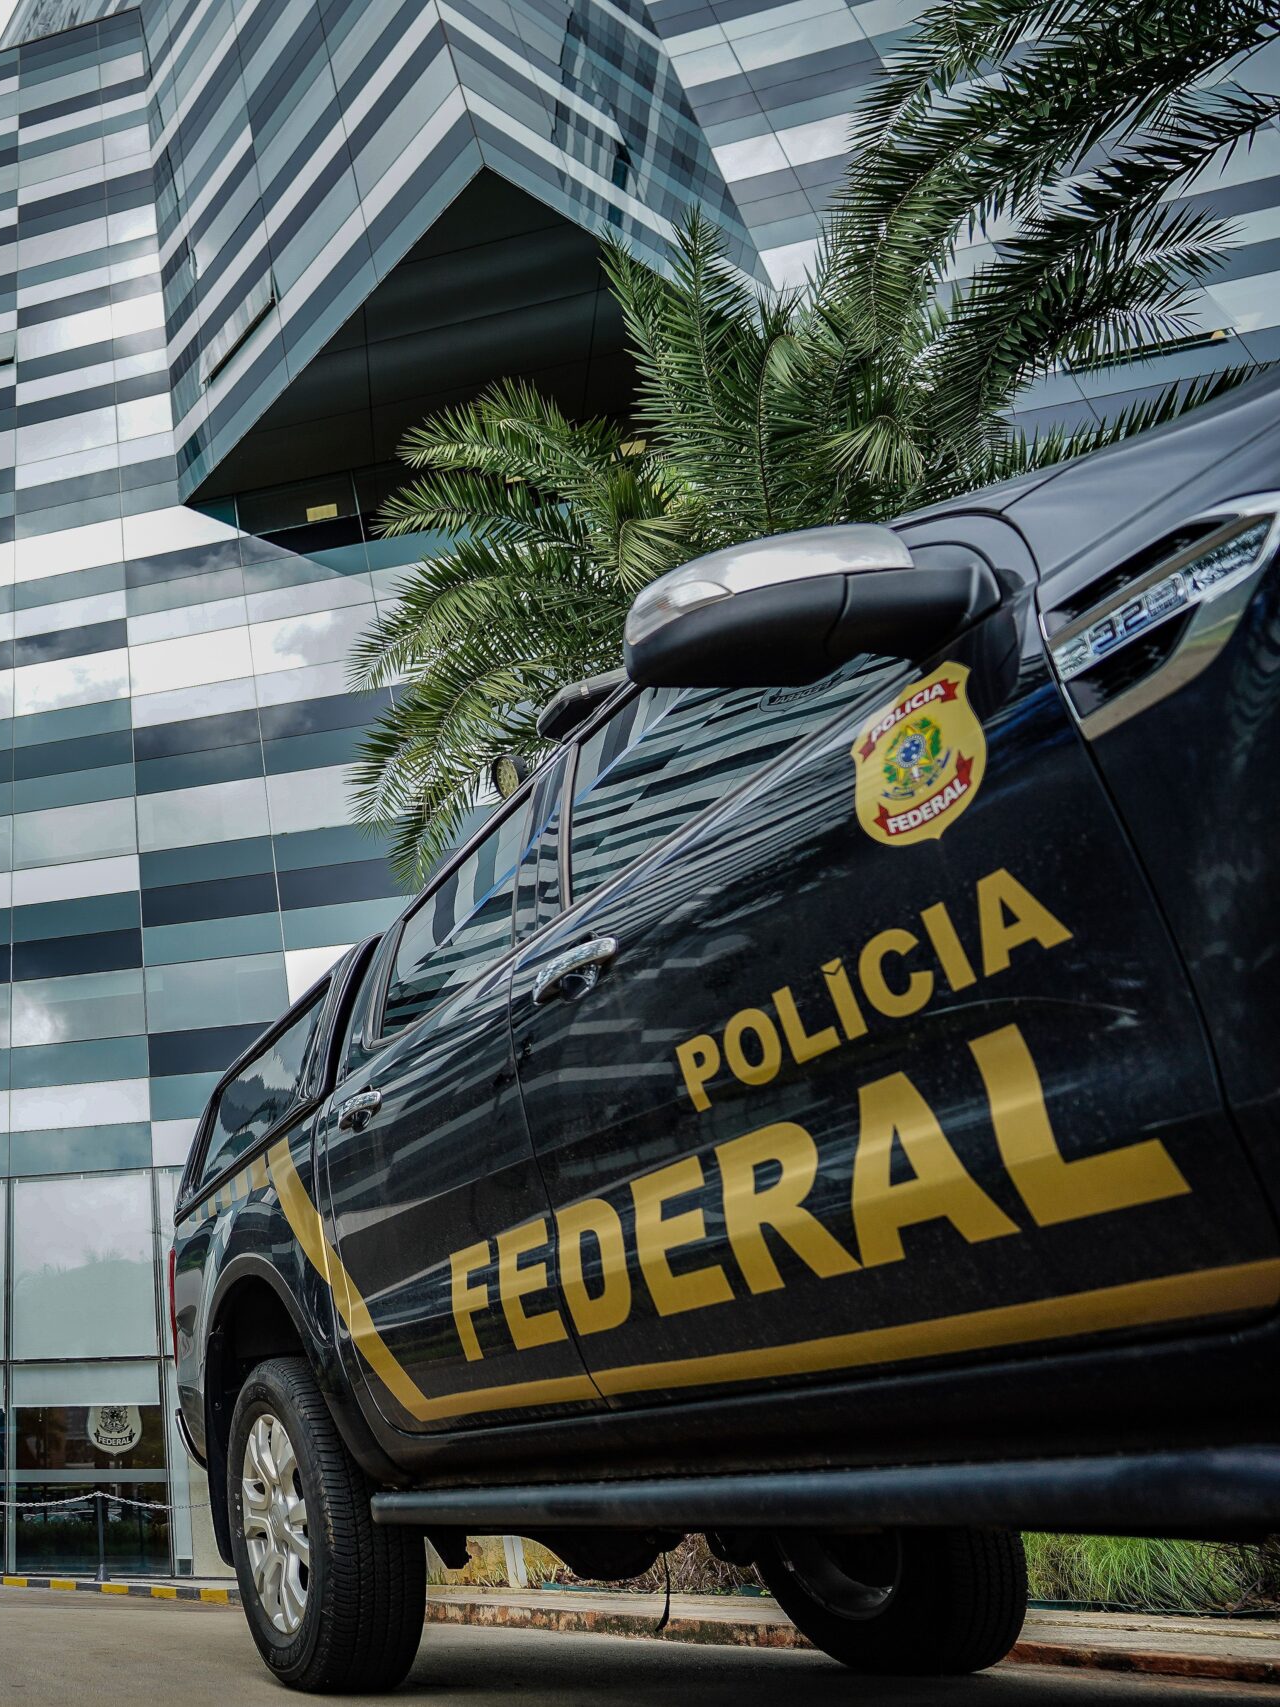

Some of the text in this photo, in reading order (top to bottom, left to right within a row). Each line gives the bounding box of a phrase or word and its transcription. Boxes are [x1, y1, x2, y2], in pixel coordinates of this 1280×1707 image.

[886, 777, 968, 834] FEDERAL
[675, 867, 1072, 1113] POLÍCIA
[449, 1023, 1191, 1361] FEDERAL
[98, 1437, 131, 1446] FEDERAL
